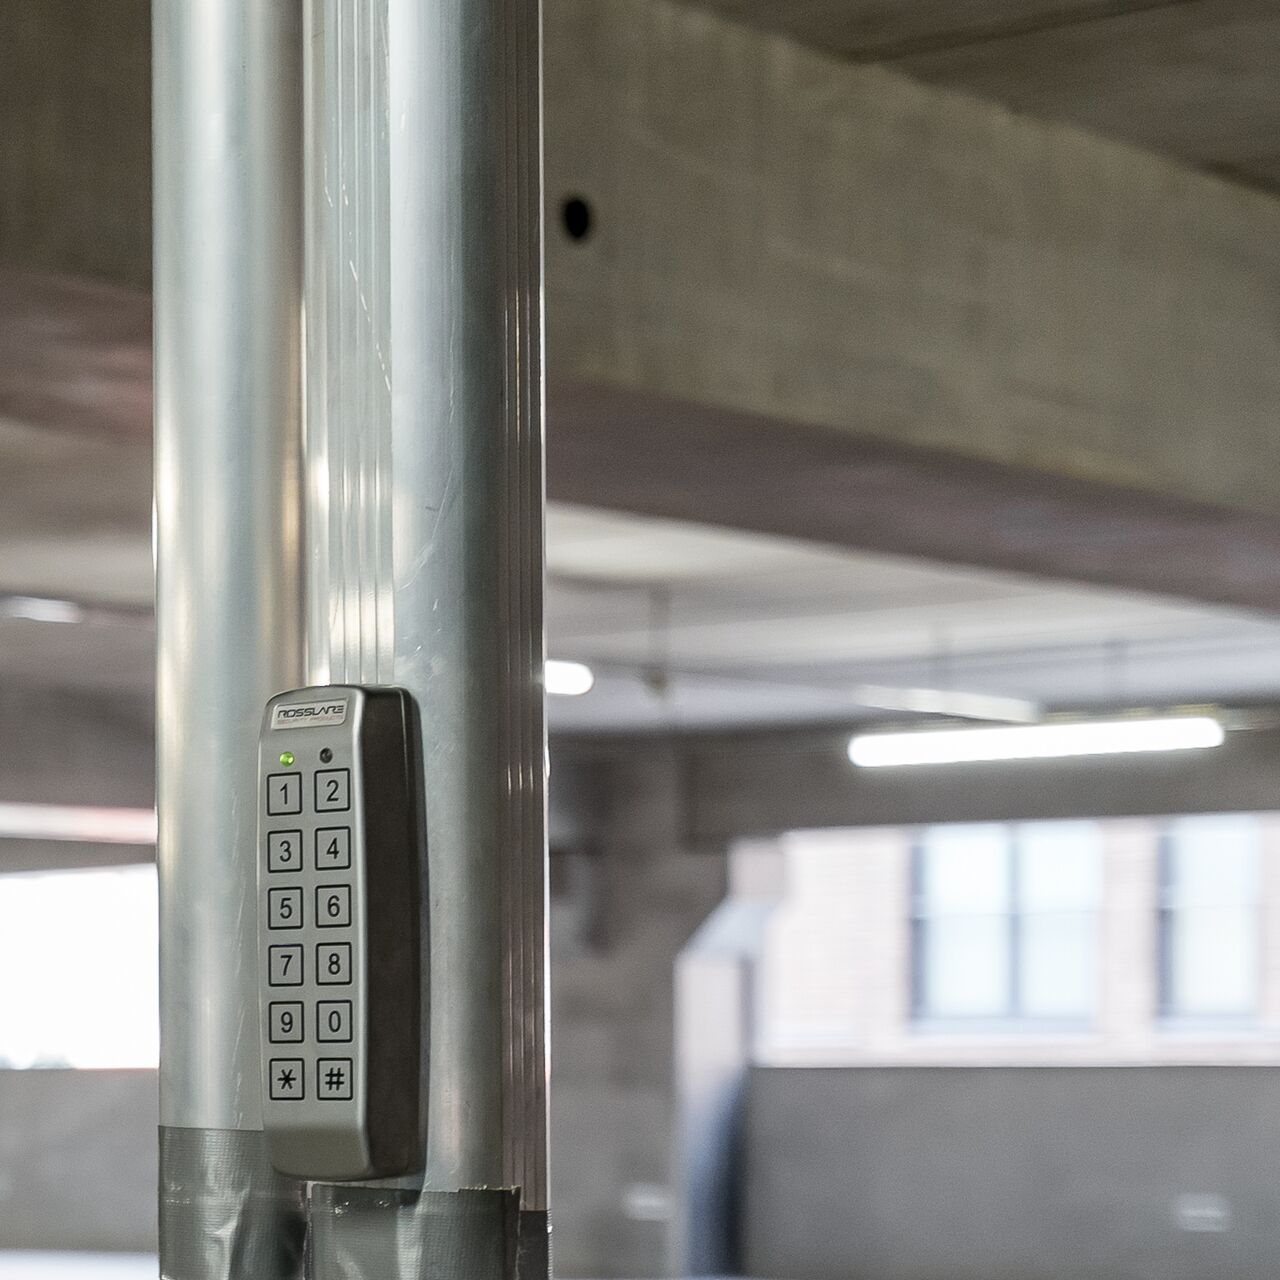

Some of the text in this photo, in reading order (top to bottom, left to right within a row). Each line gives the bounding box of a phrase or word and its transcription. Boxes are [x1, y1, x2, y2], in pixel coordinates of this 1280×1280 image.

[278, 705, 344, 719] ROSSLARE
[279, 779, 340, 806] 1 2
[279, 836, 340, 863] 3 4
[279, 894, 341, 920] 5 6
[279, 952, 341, 977] 7 8
[280, 1009, 342, 1034] 9 0
